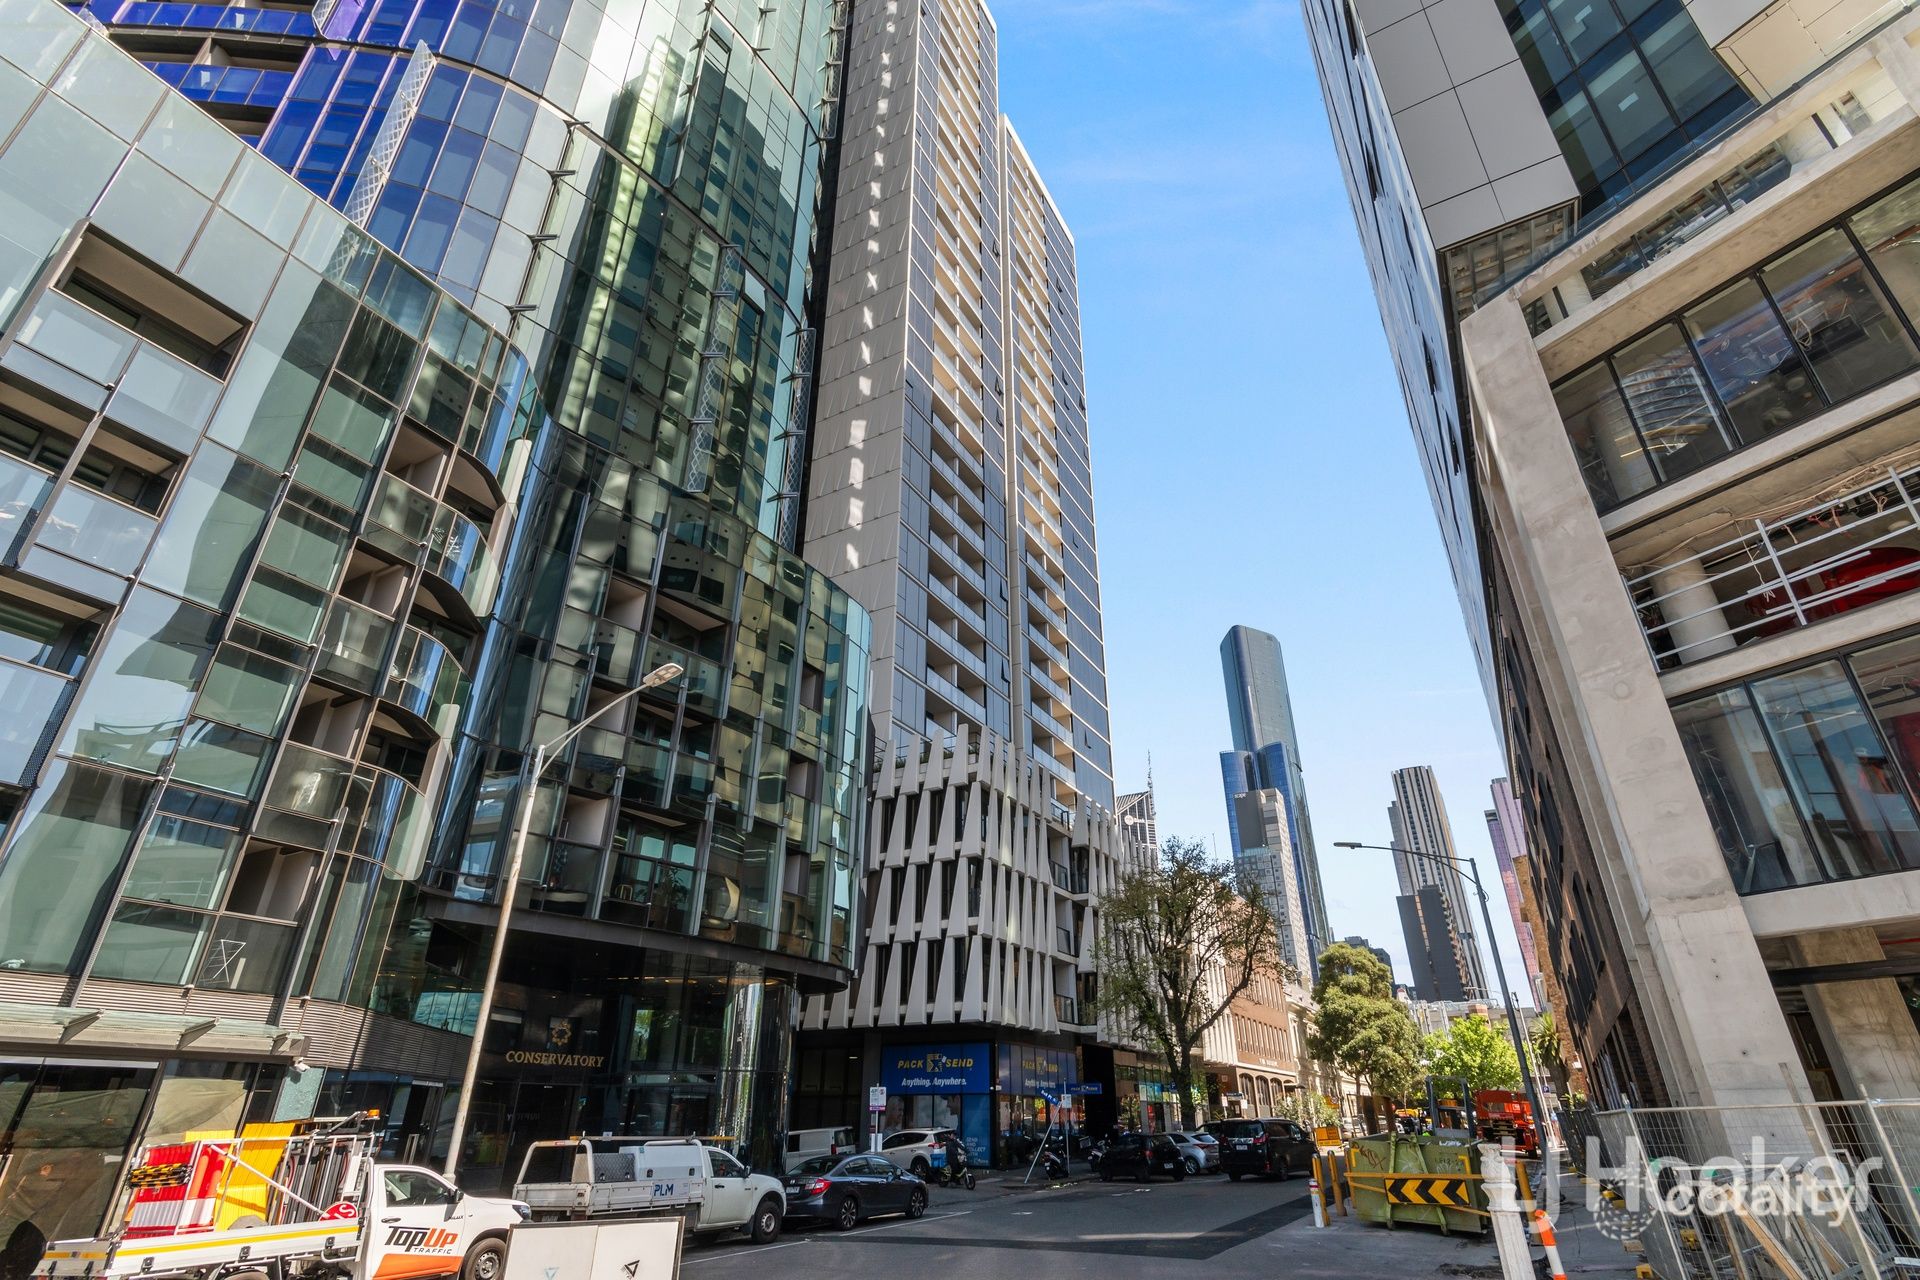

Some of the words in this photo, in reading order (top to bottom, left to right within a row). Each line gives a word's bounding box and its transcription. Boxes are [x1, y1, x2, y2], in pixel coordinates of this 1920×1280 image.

[505, 1050, 604, 1068] CONSERVATORY
[898, 1060, 923, 1069] PACK
[945, 1058, 974, 1068] SEND
[653, 1183, 674, 1197] PLM
[413, 1247, 452, 1255] TRAFFIC
